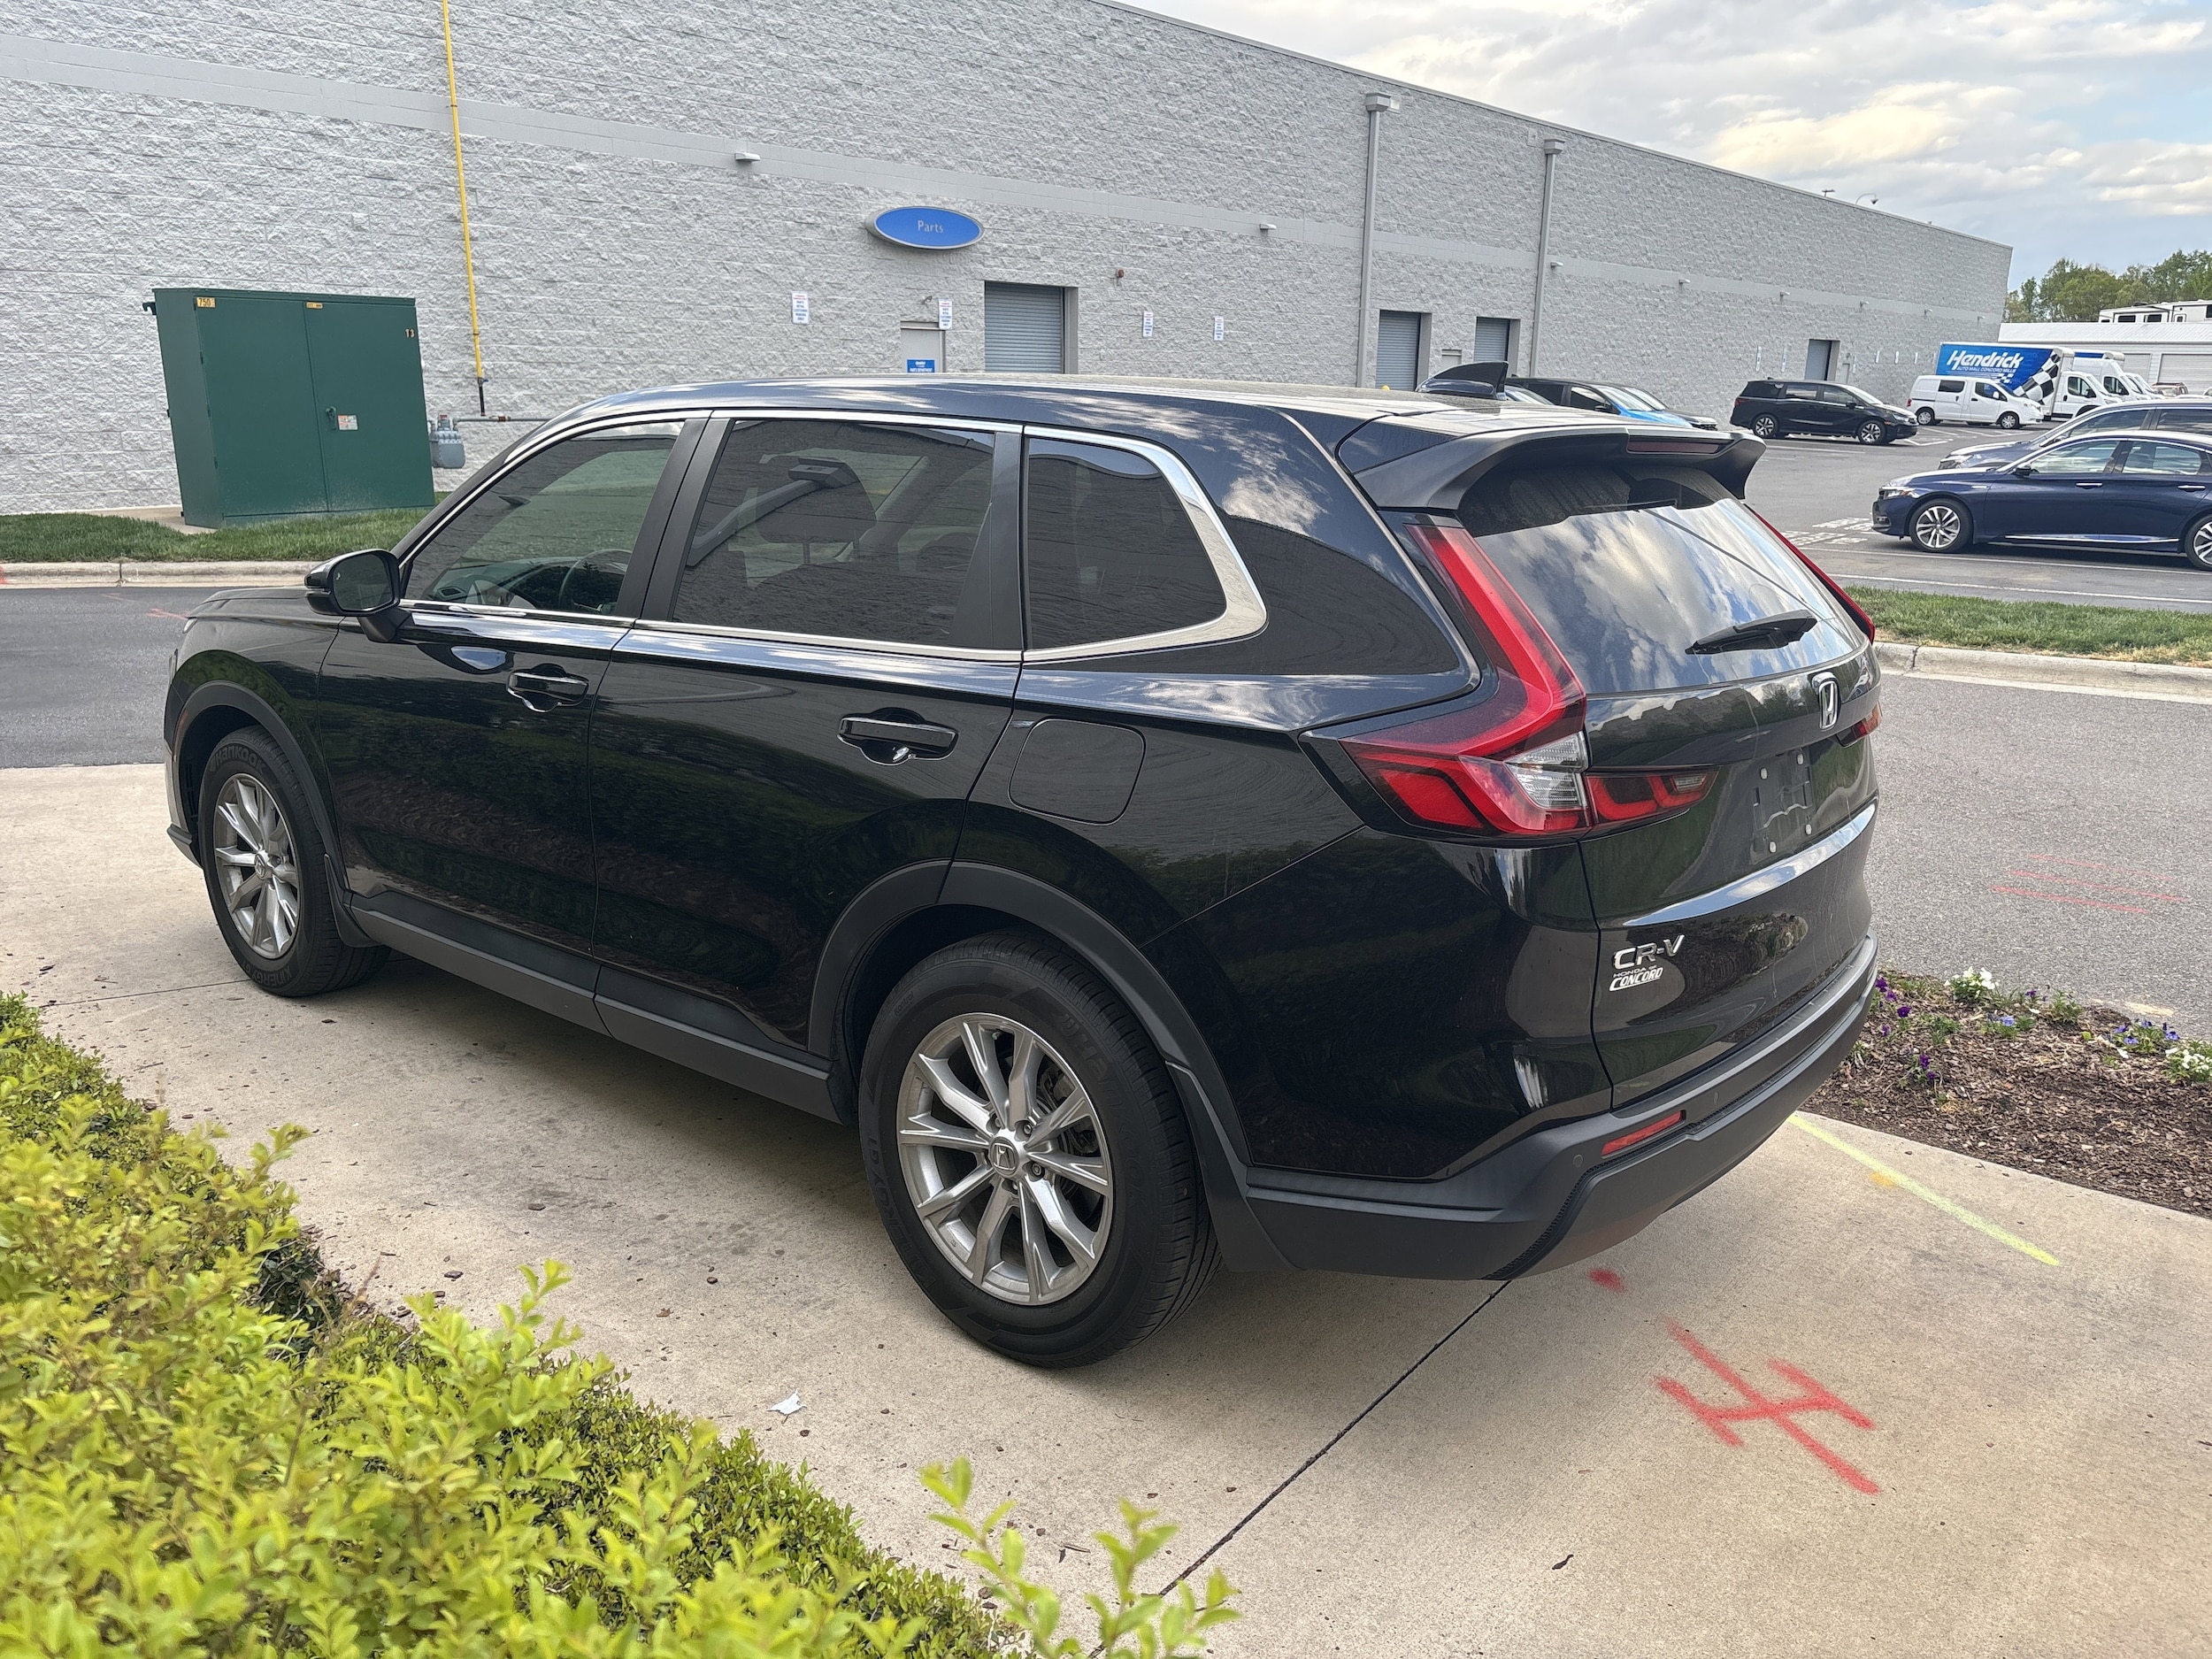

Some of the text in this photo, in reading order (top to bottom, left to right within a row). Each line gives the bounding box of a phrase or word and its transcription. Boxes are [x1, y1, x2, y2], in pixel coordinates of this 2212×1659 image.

[918, 219, 943, 234] Parts
[1946, 349, 2024, 371] Hendrick
[1614, 934, 1685, 970] CR-V
[1609, 967, 1663, 991] CONCORD
[1613, 967, 1647, 978] HONDA
